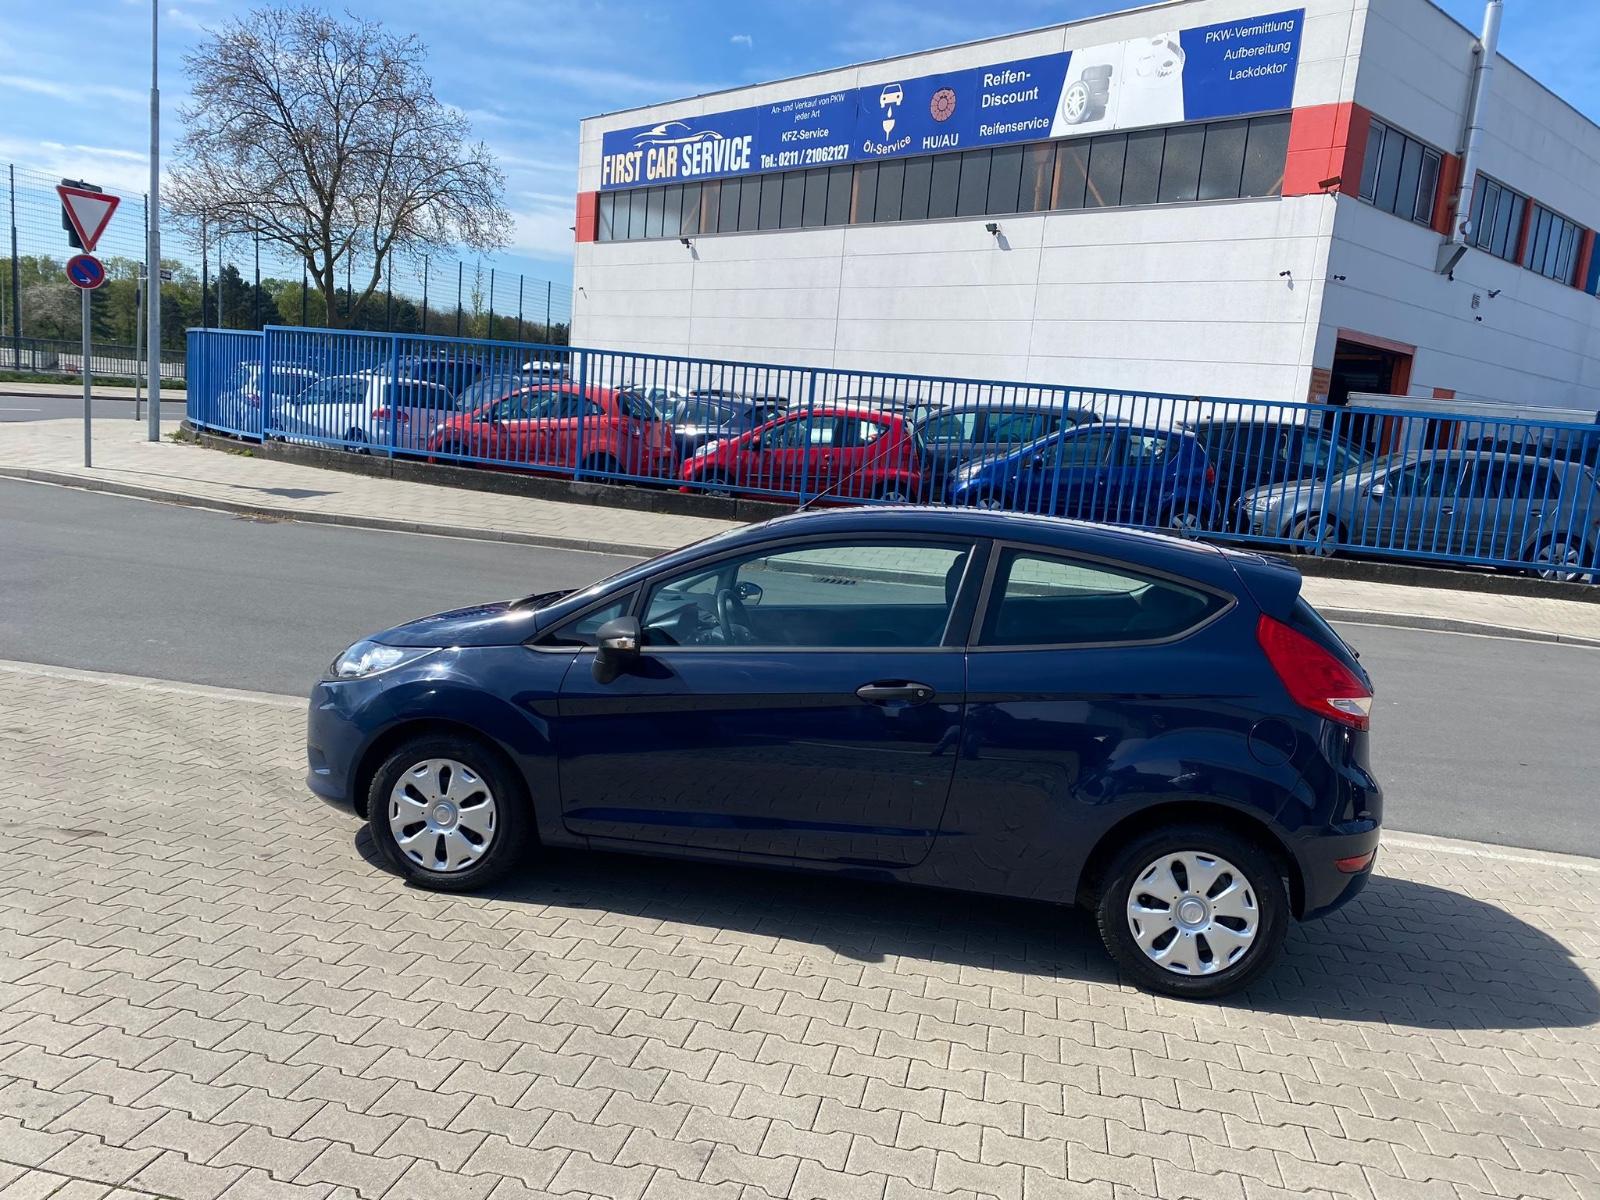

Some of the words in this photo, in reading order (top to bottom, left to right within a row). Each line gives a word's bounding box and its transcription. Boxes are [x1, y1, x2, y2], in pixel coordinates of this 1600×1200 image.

[1205, 20, 1294, 43] PKW-Vermittlung
[1223, 41, 1291, 60] Aufbereitung
[983, 70, 1031, 87] Reifen-
[1229, 63, 1288, 80] Lackdoktor
[783, 103, 793, 112] und
[795, 99, 817, 110] Verkauf
[831, 93, 845, 103] PKW
[982, 86, 1039, 108] Discount
[794, 112, 810, 123] jeder
[811, 109, 820, 118] Art
[781, 128, 829, 142] KFZ-Service
[979, 117, 1050, 136] Reifenservice
[863, 135, 911, 155] Öl-Service
[922, 133, 959, 149] HU/AU
[602, 151, 643, 185] FIRST
[646, 146, 678, 180] CAR
[682, 135, 752, 177] SERVICE
[779, 150, 798, 166] 0211
[806, 144, 849, 163] 21062127
